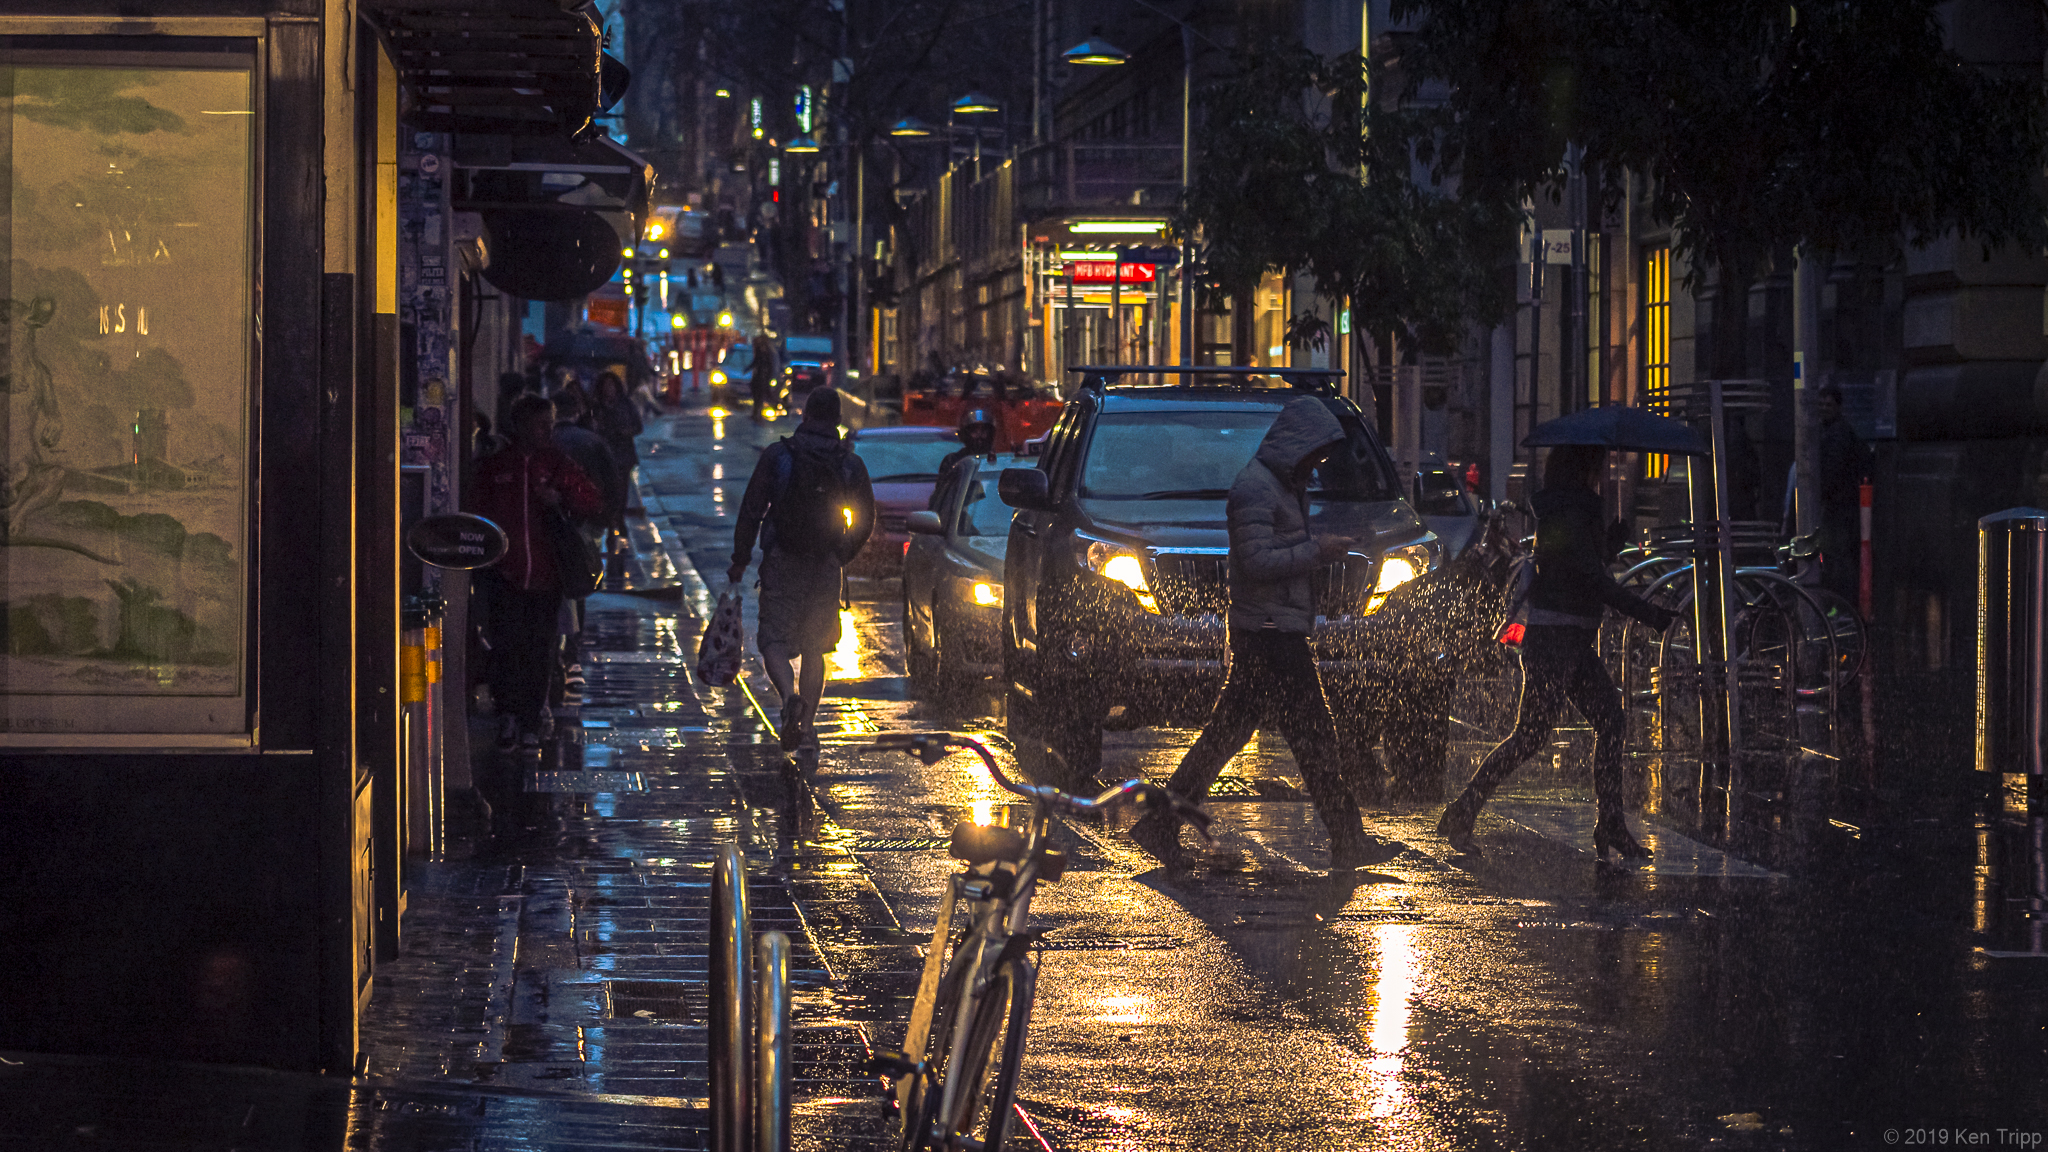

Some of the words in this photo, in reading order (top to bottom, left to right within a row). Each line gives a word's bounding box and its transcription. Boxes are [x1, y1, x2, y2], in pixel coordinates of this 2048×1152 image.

[1076, 264, 1093, 277] MFB
[460, 532, 485, 542] NOW
[458, 545, 485, 555] OPEN
